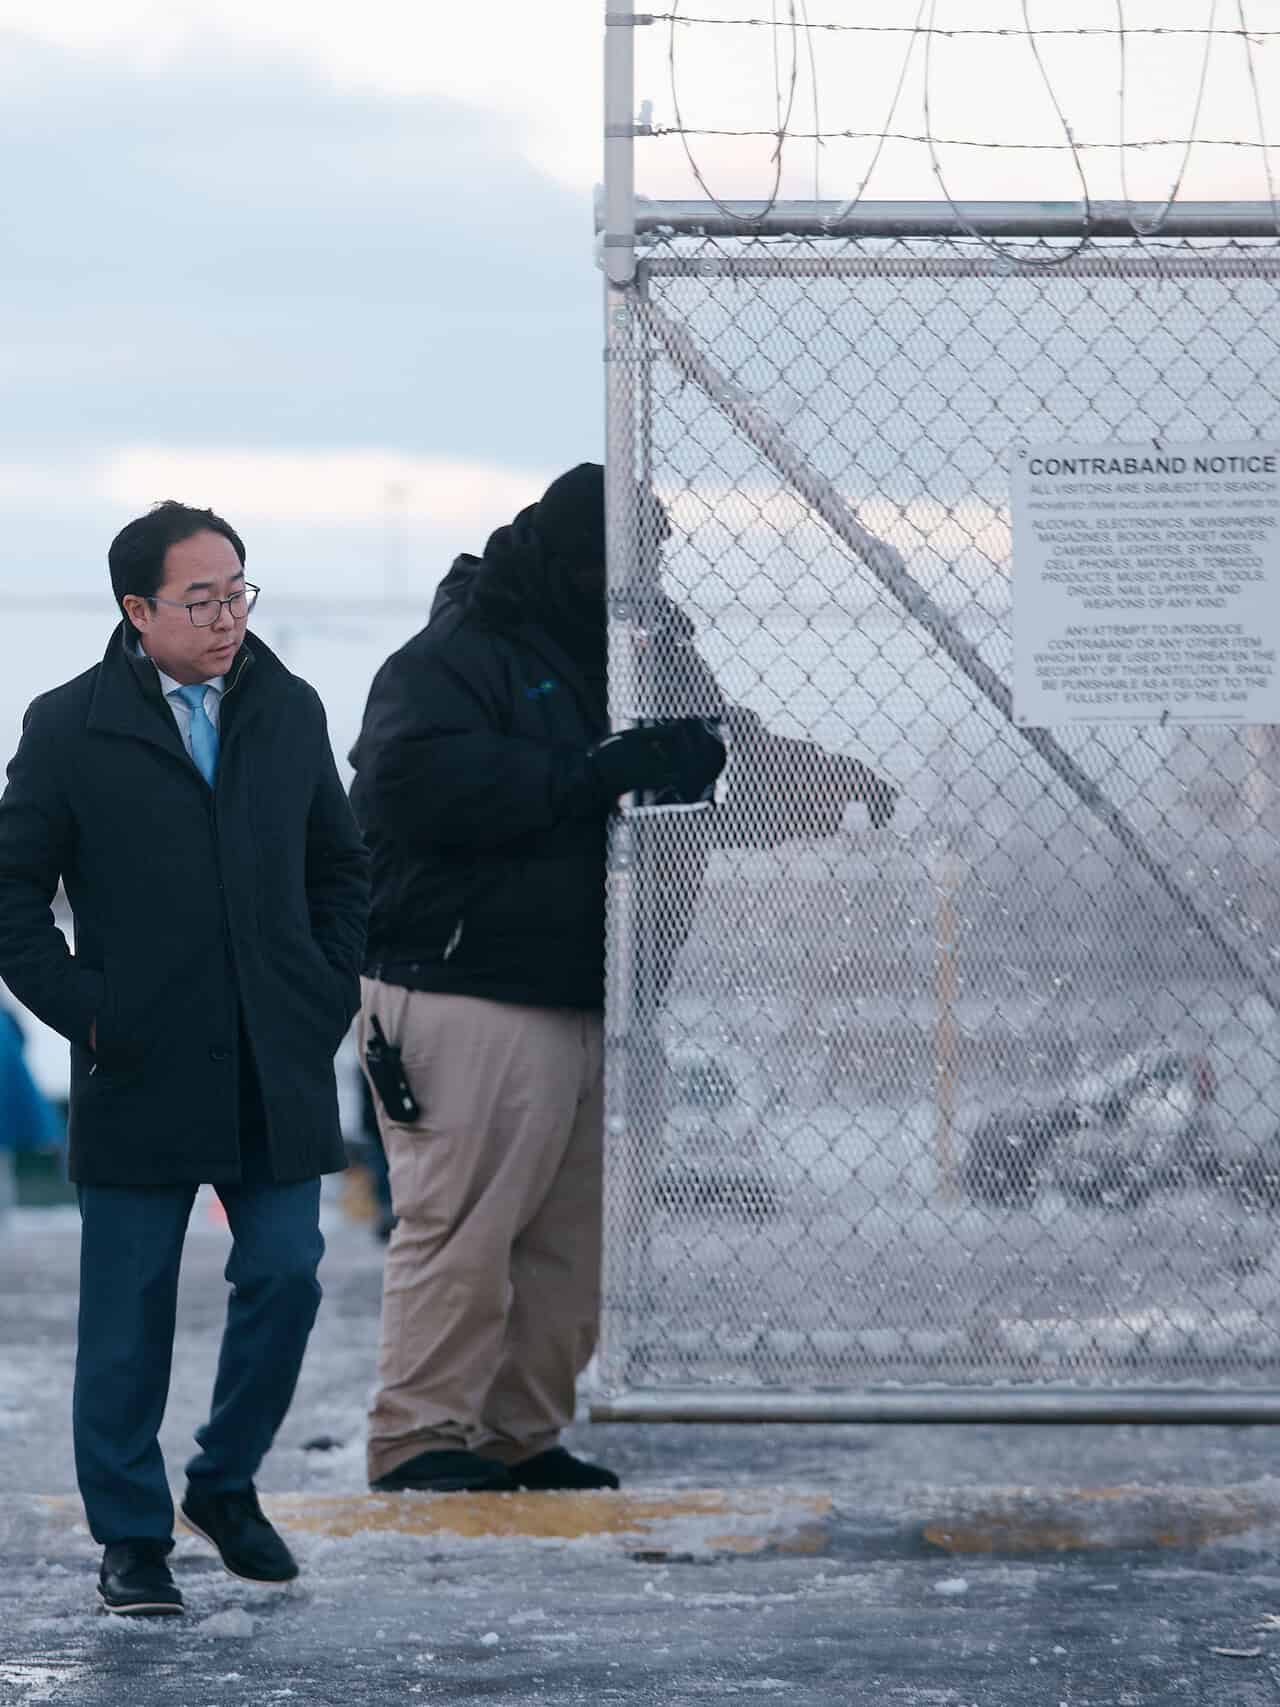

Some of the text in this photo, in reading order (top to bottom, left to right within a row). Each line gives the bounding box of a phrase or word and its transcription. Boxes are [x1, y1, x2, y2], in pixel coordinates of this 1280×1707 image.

[1029, 455, 1277, 475] CONTRABAND NOTICE
[1152, 625, 1167, 634] TO
[1165, 652, 1180, 661] TO
